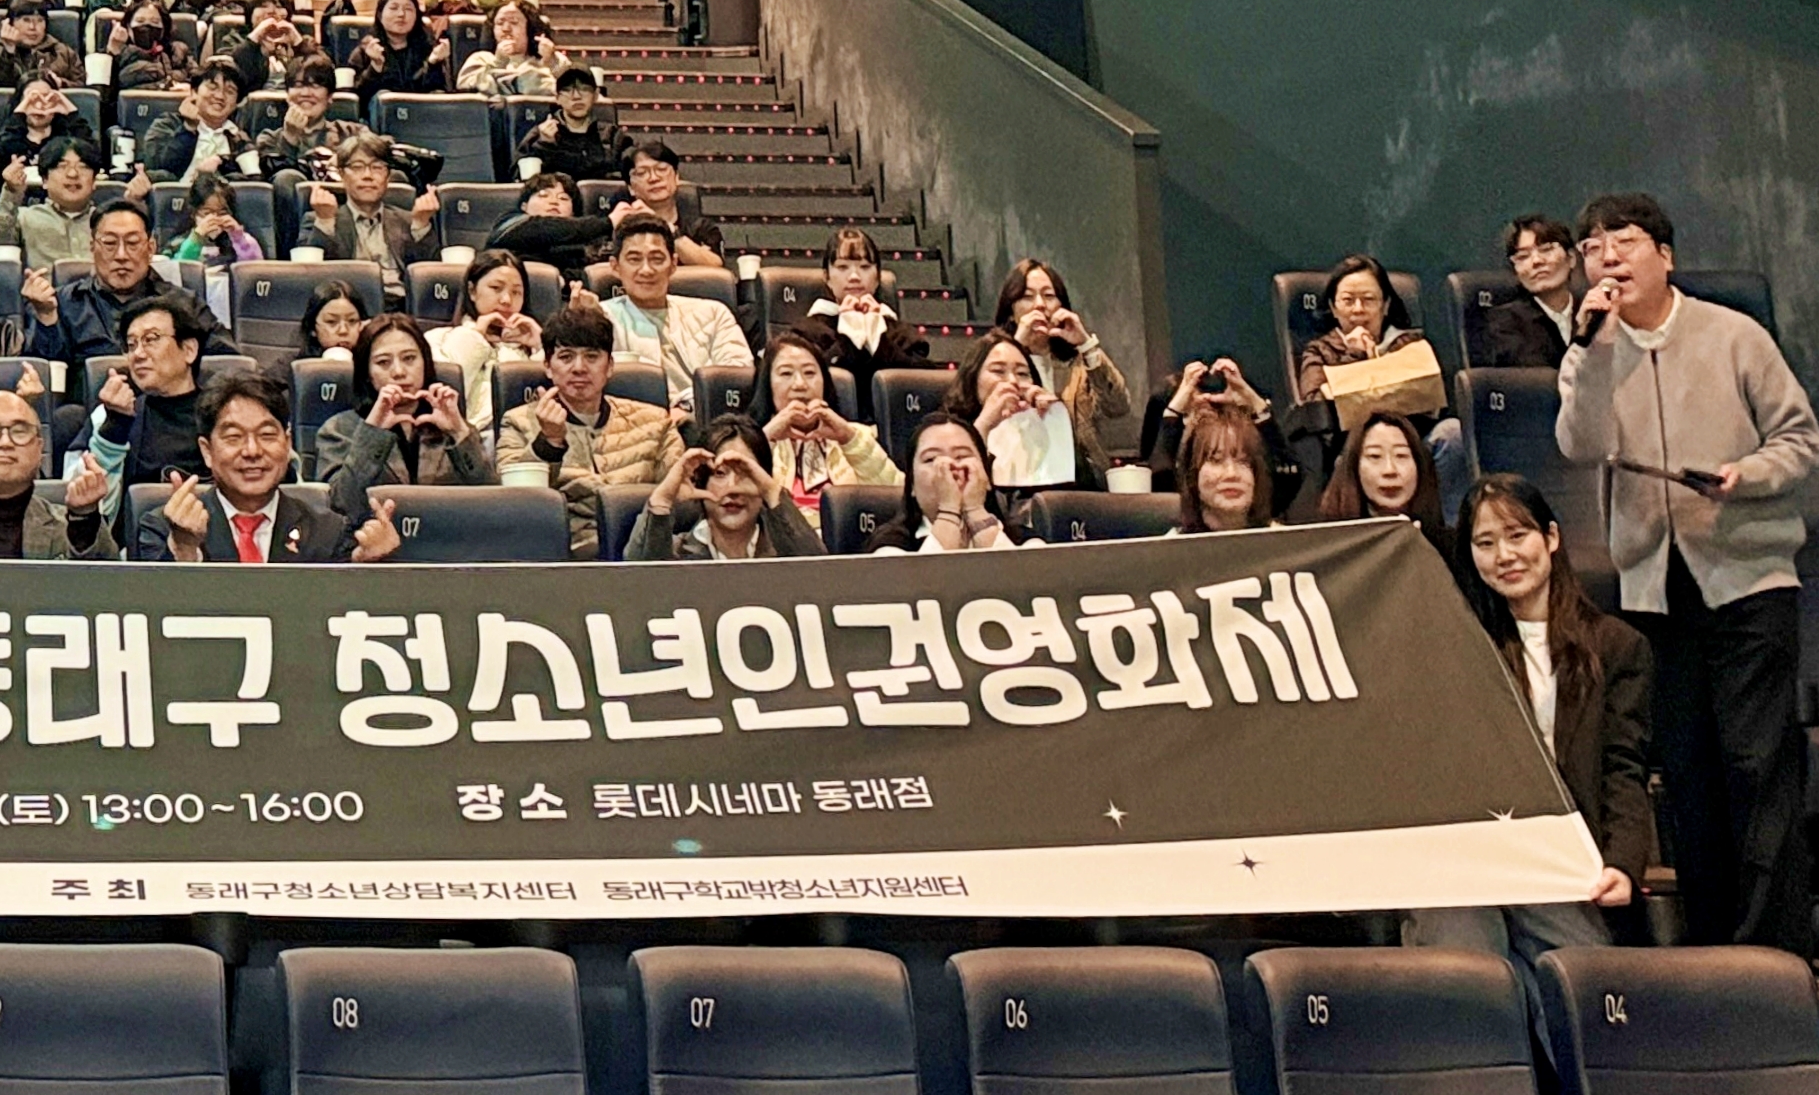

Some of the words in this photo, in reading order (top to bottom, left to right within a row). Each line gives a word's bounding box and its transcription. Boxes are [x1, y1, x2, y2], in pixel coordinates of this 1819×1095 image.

[172, 198, 184, 211] 07
[457, 200, 469, 213] 05
[599, 196, 610, 209] 04
[256, 281, 270, 296] 07
[434, 283, 448, 299] 06
[783, 287, 796, 302] 04
[1303, 294, 1317, 310] 03
[1478, 291, 1492, 307] 02
[321, 383, 337, 401] 07
[726, 389, 740, 407] 05
[1490, 392, 1505, 410] 03
[906, 394, 920, 411] 04
[402, 517, 420, 537] 07
[859, 512, 875, 532] 05
[1071, 521, 1086, 540] 04
[327, 571, 1359, 747] 청소년인권영화제
[593, 781, 802, 819] 롯데시네마
[812, 776, 934, 812] 동래점
[81, 790, 364, 825] 13:00~16:00
[186, 881, 578, 901] 동래구청소년상담복지센터
[602, 875, 970, 901] 동래구학교밖청소년지원센터
[332, 997, 358, 1028] 08
[690, 997, 715, 1028] 07
[1005, 998, 1028, 1028] 06
[1307, 994, 1329, 1024] 05
[1605, 994, 1627, 1024] 04
